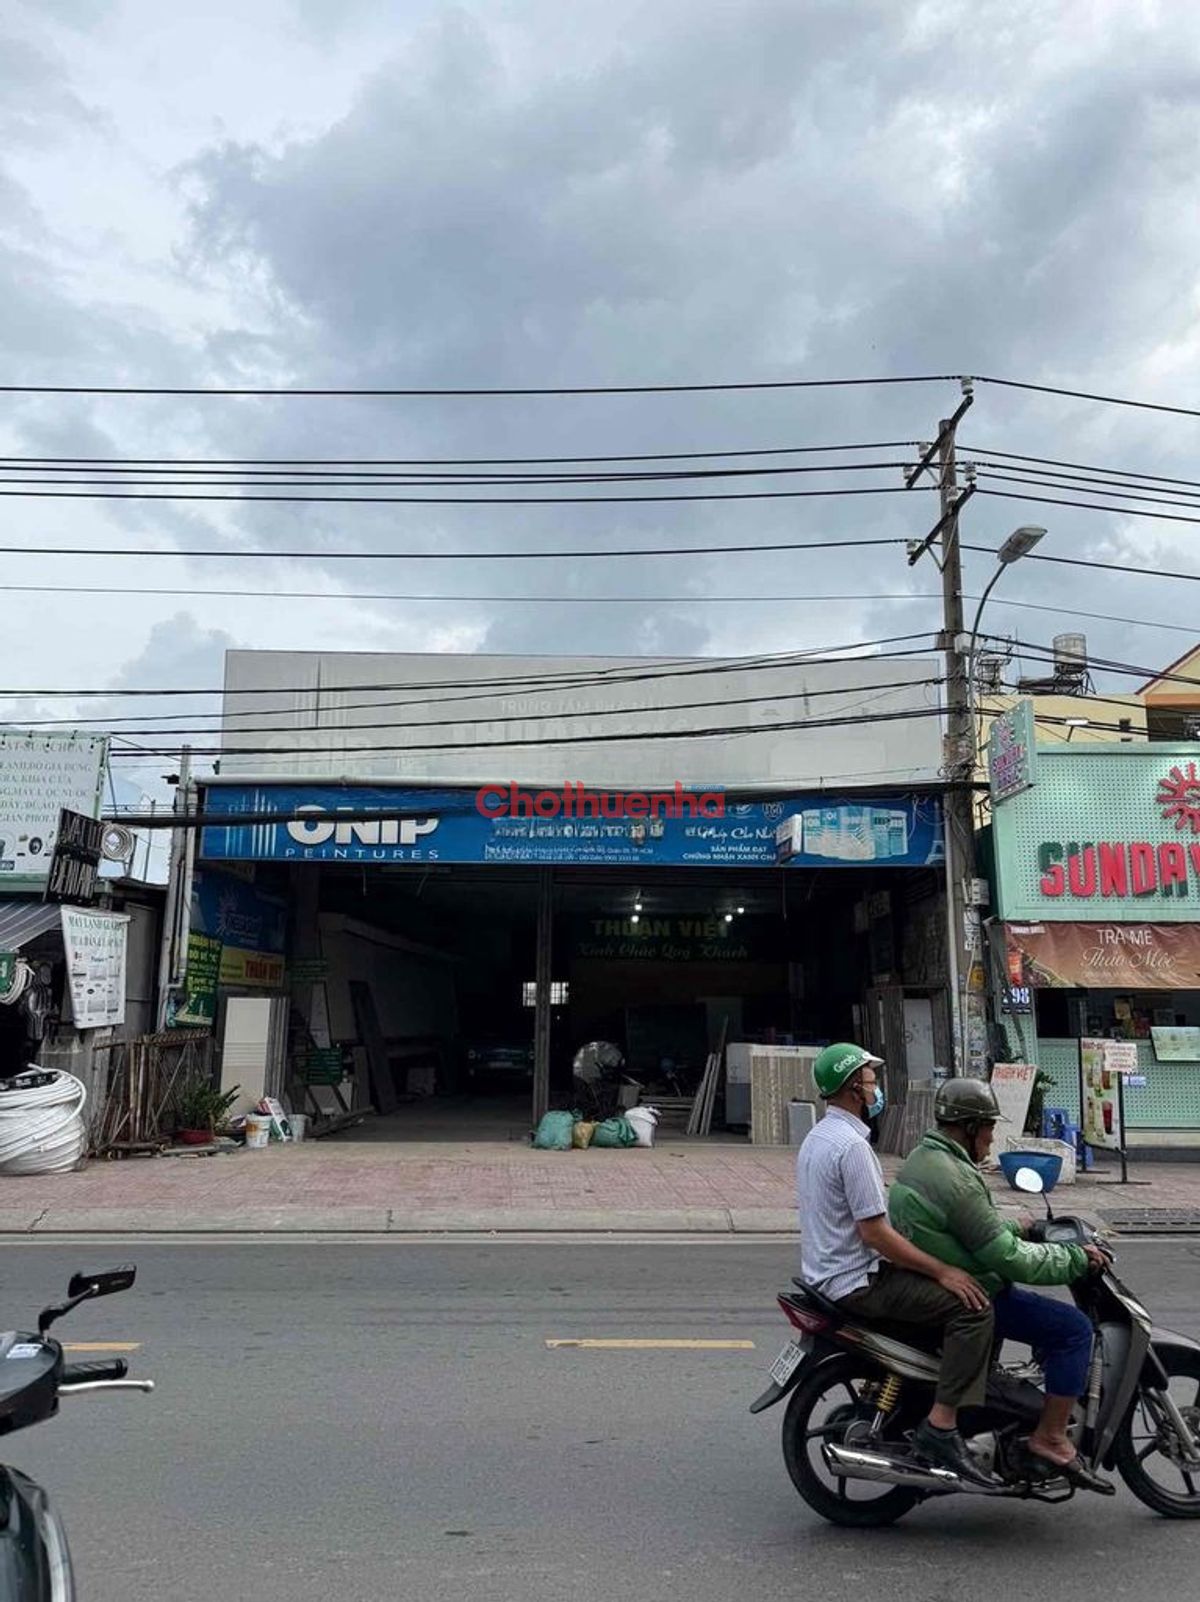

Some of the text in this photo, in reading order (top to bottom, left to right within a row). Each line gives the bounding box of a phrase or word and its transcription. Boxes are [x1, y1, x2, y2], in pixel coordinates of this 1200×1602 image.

[286, 804, 439, 845] ONIP
[286, 849, 439, 860] PEINTURES
[833, 1054, 857, 1073] Grab
